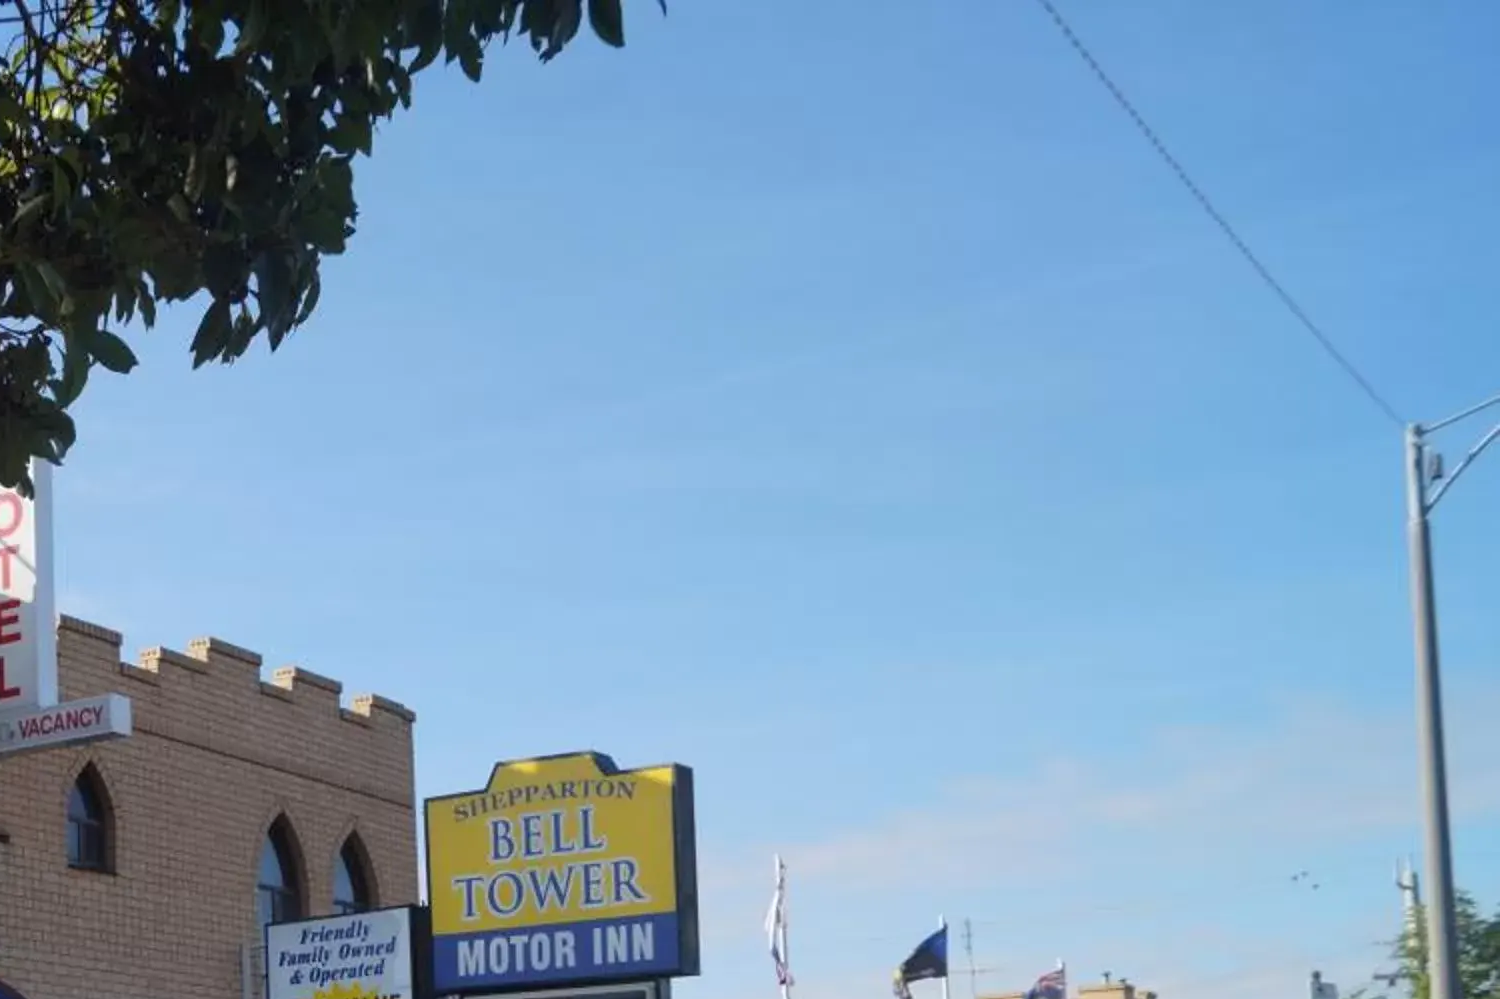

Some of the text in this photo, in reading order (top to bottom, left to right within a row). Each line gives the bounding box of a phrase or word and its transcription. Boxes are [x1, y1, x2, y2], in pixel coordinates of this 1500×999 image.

[18, 704, 104, 739] VACANCY
[453, 779, 637, 822] SHEPPARTON
[490, 806, 606, 862] BELL
[454, 859, 647, 918] TOWER
[278, 935, 397, 967] Family Owned
[300, 920, 370, 945] Friendly
[457, 922, 655, 977] MOTOR INN
[290, 959, 386, 987] & Operated
